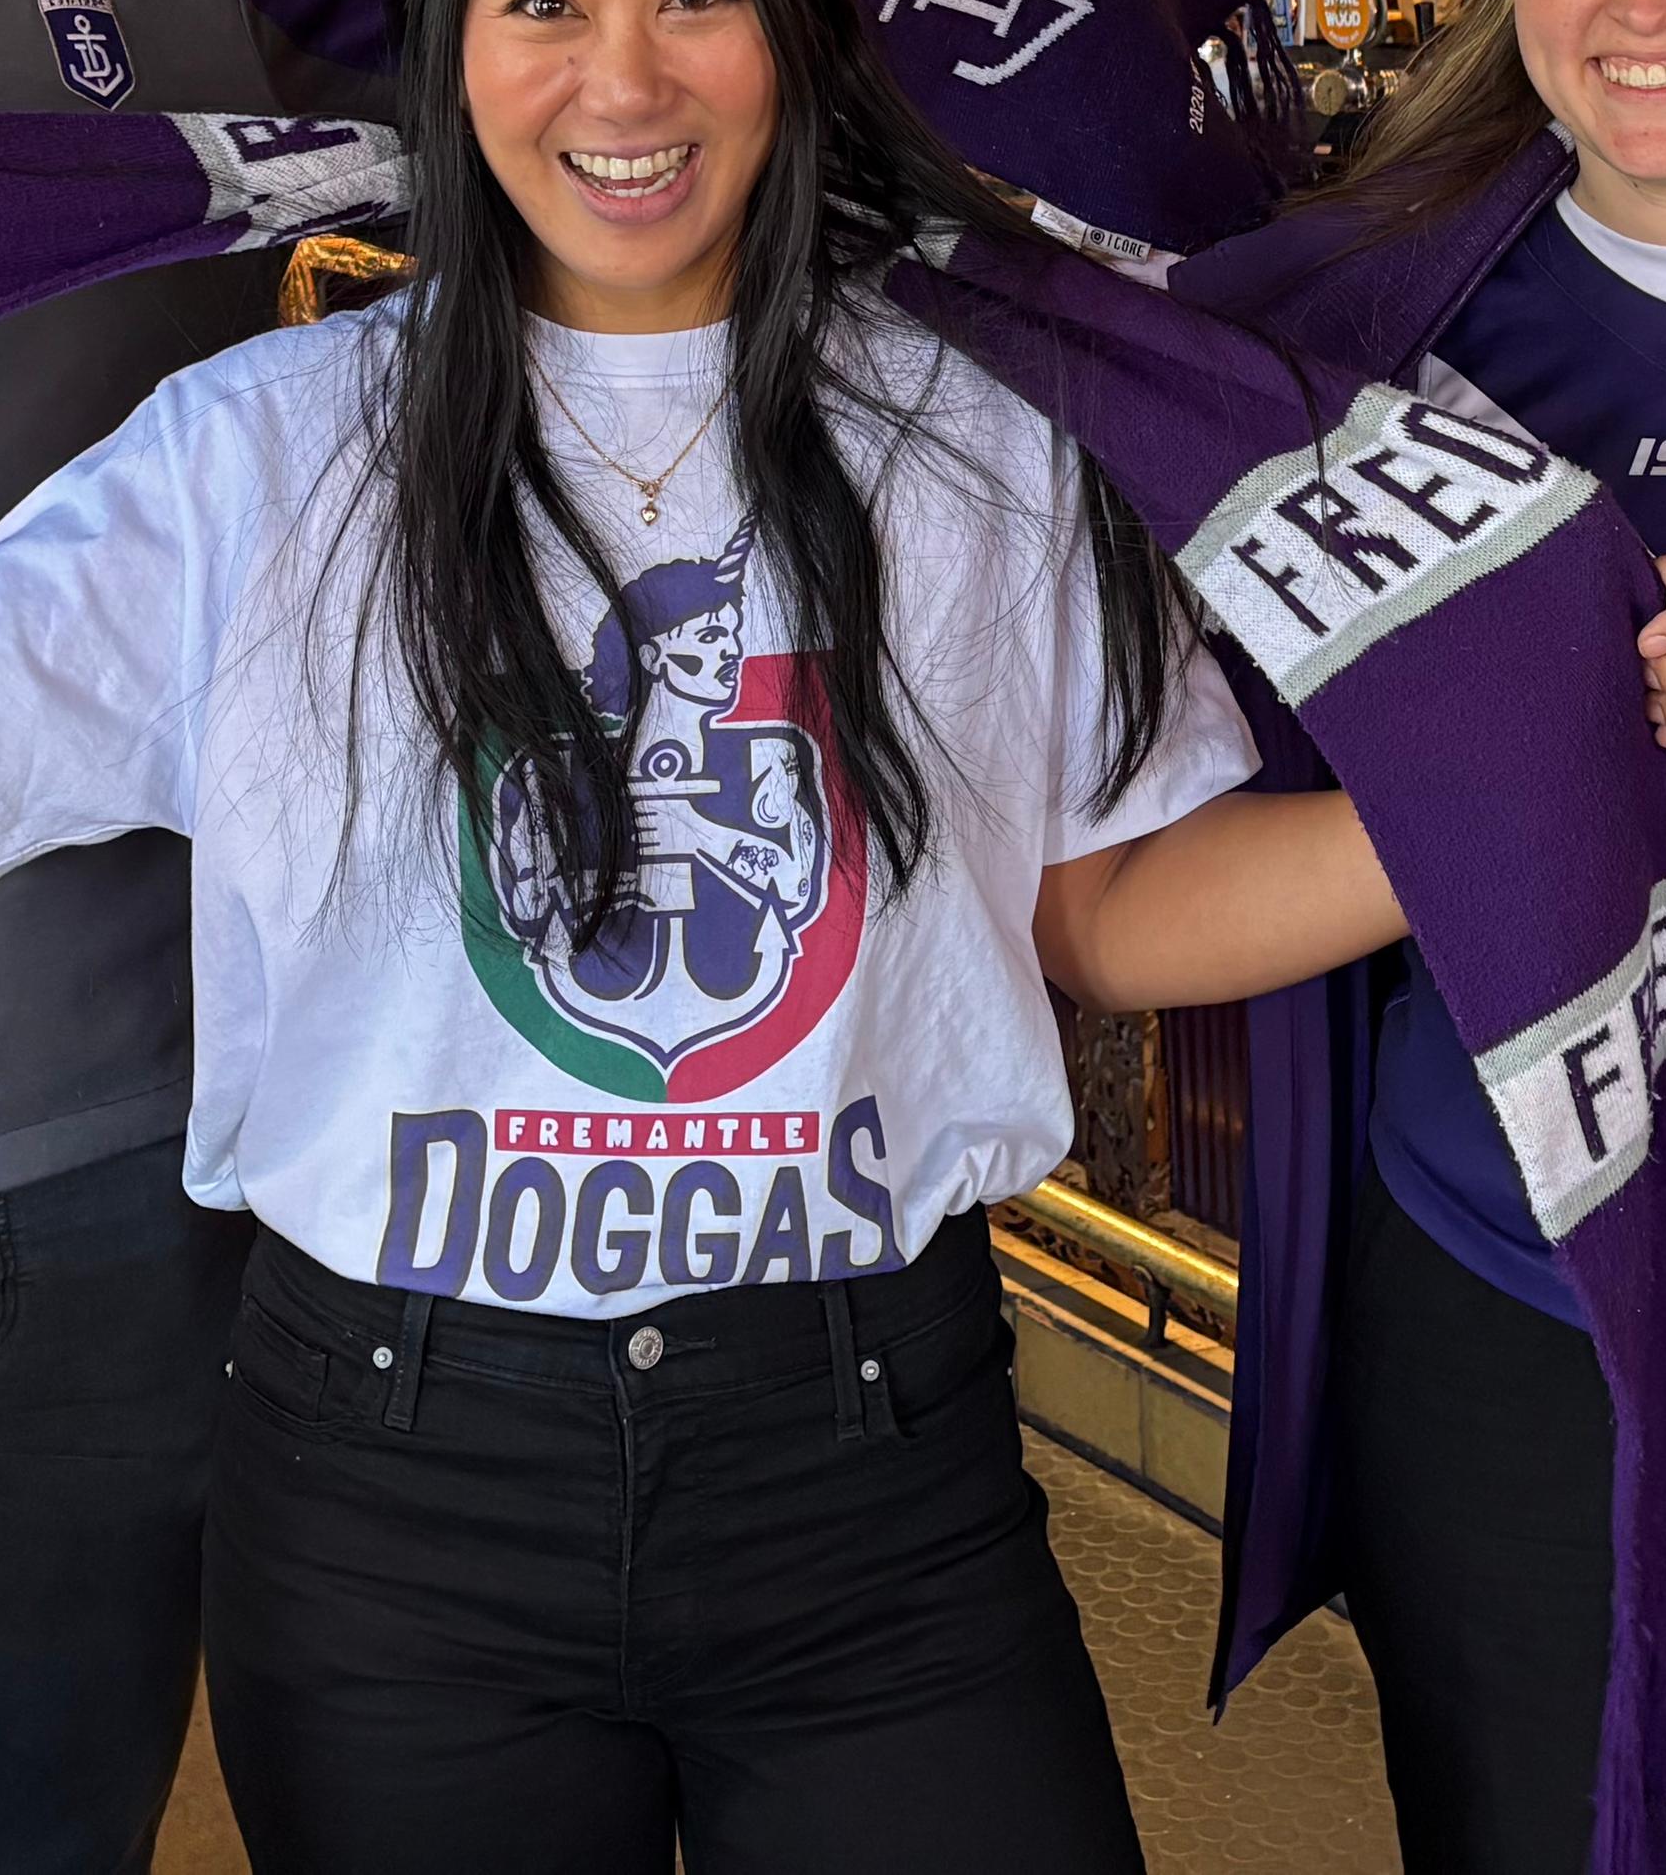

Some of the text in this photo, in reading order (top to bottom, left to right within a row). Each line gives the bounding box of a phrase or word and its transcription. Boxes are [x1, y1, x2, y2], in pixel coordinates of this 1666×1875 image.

[1324, 10, 1361, 28] WOOD
[1189, 85, 1205, 135] 2020
[1231, 401, 1550, 637] FREO
[506, 1115, 805, 1150] FREMANTLE
[375, 1094, 908, 1302] DOGGAS
